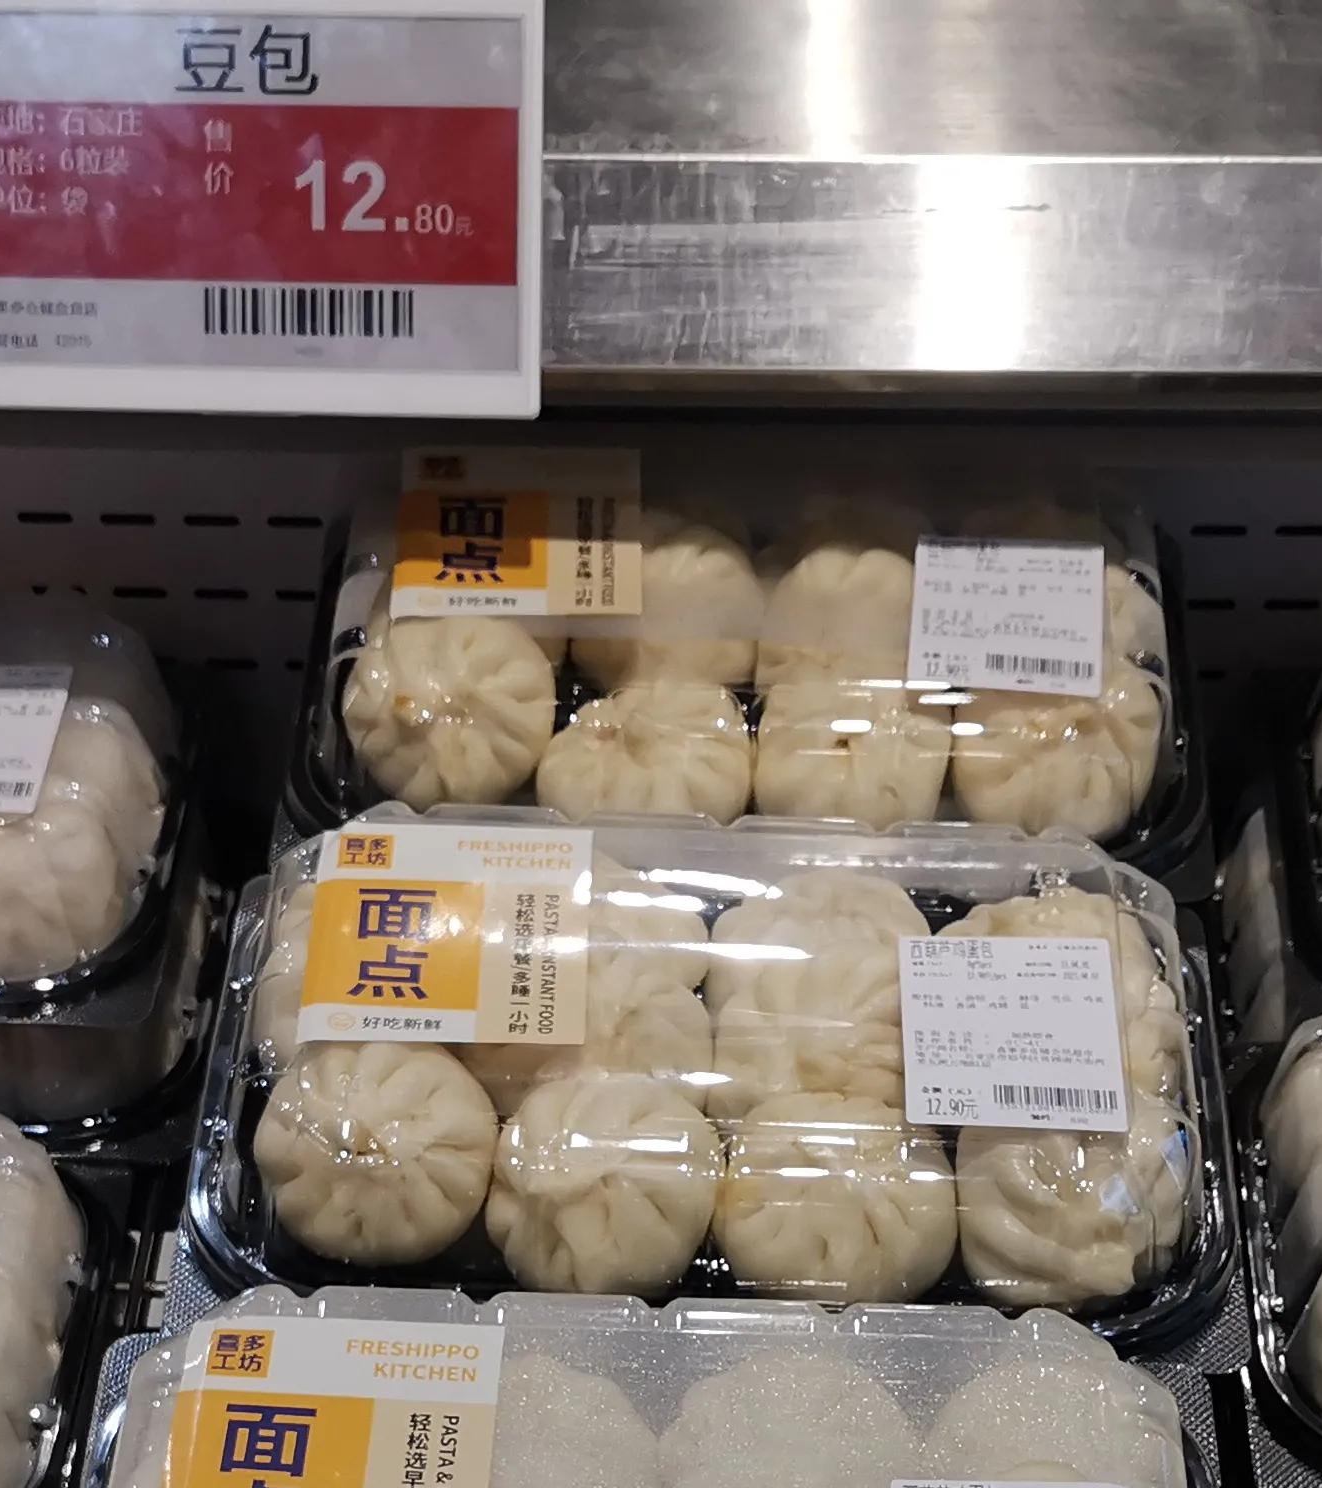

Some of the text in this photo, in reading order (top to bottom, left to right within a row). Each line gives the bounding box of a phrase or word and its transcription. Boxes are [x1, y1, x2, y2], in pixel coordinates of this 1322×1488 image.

[174, 24, 320, 96] 豆包
[435, 497, 507, 583] 面点
[347, 888, 437, 999] 面点
[346, 1338, 480, 1360] FRESHIPPO
[374, 1363, 478, 1382] KITCHEN
[438, 1415, 459, 1469] PASTA
